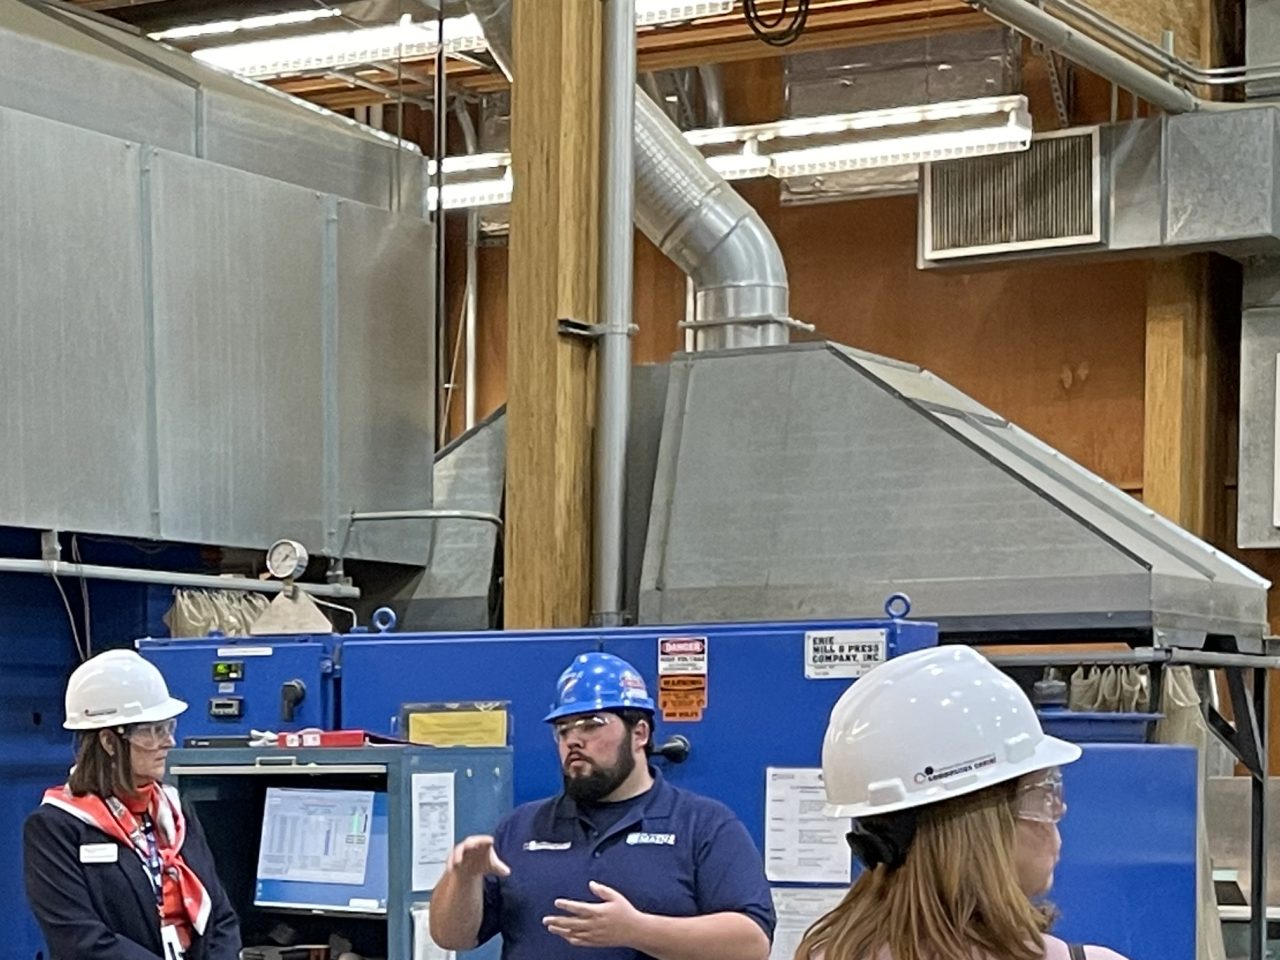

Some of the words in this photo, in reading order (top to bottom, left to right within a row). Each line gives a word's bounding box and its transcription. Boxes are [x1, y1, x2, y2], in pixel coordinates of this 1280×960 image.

[812, 636, 835, 645] ERIE
[665, 642, 701, 653] DANGER
[813, 645, 835, 653] MILL
[848, 644, 879, 653] PRESS
